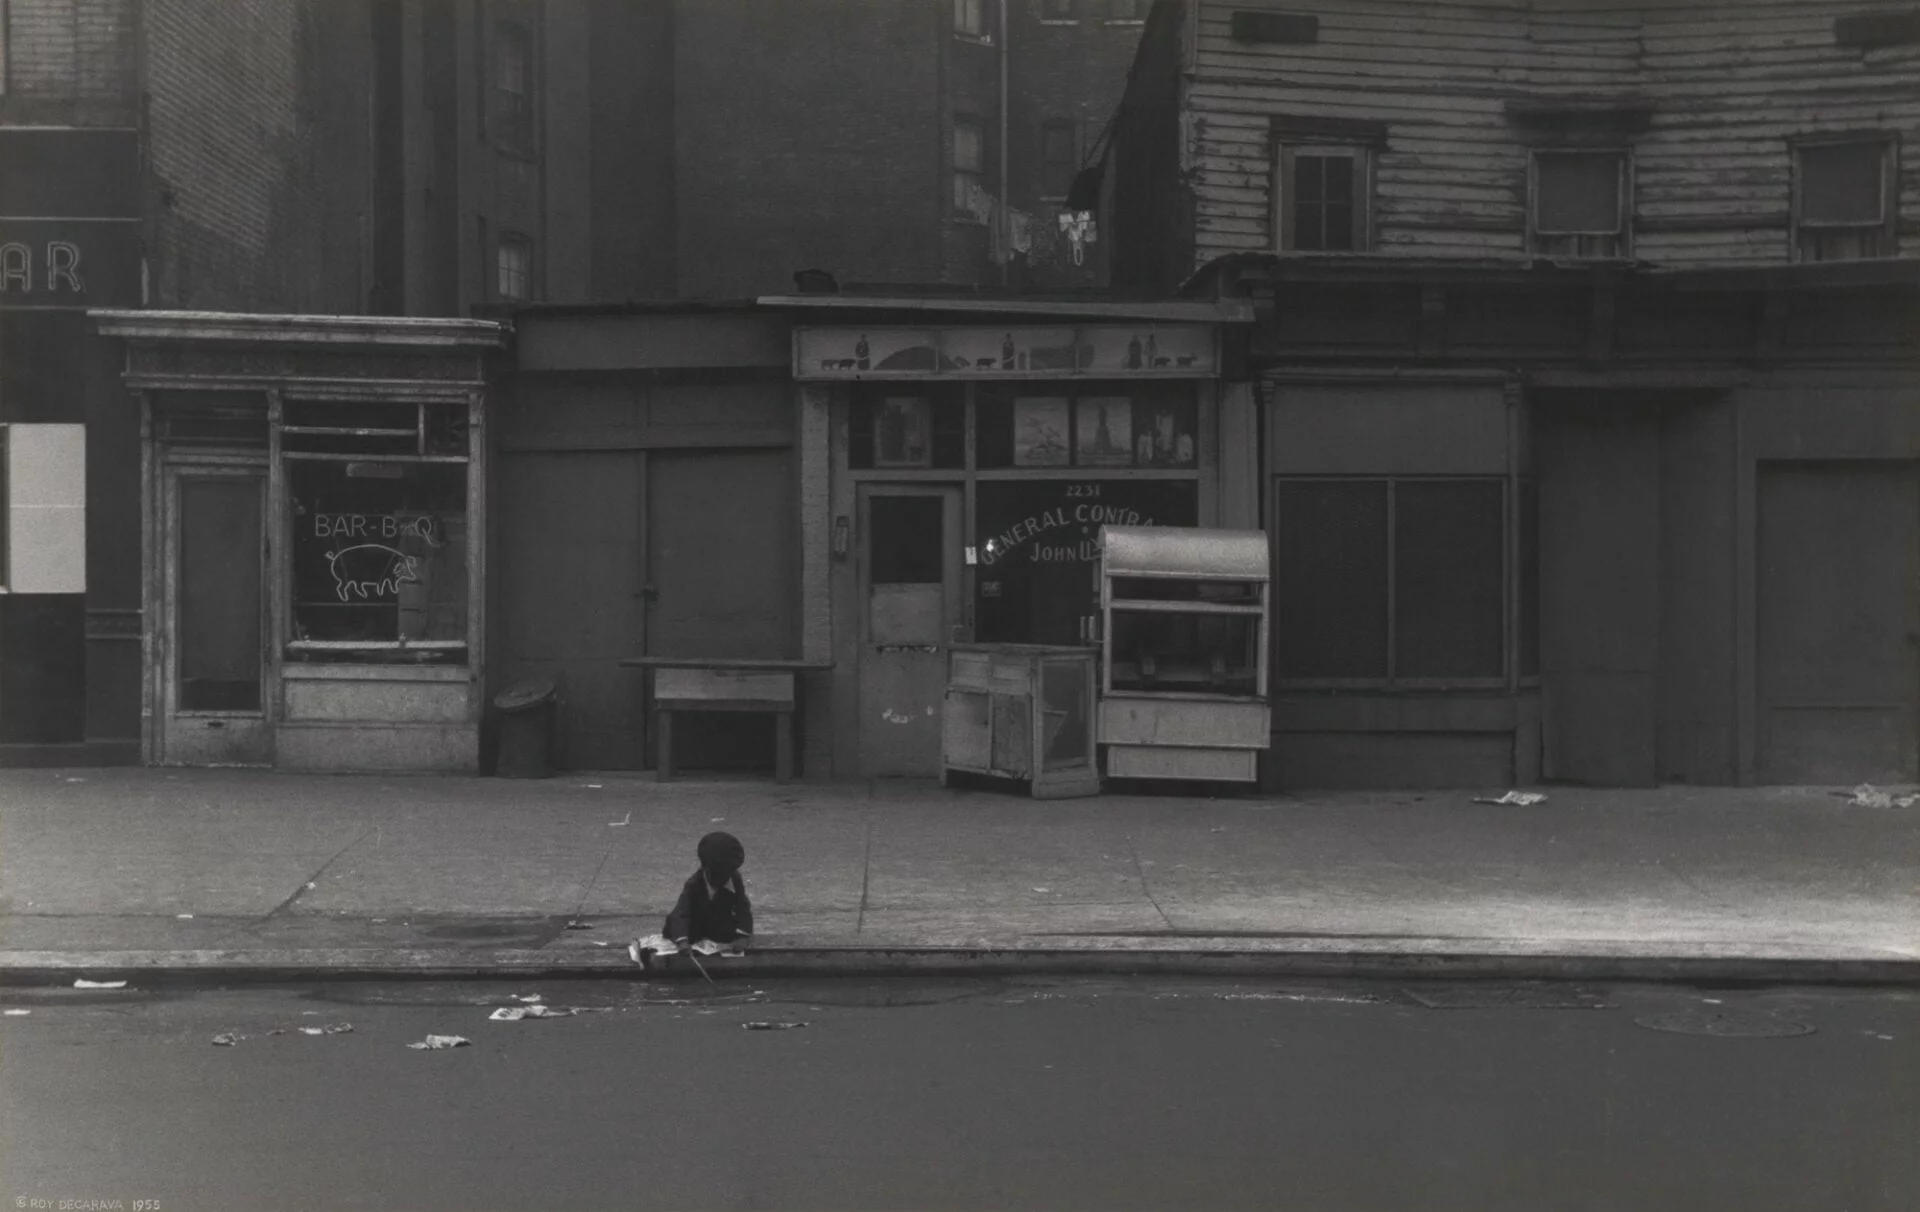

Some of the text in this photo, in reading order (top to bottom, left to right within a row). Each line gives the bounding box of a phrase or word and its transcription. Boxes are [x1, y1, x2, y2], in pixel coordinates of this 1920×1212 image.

[1066, 484, 1100, 497] 2231
[980, 507, 1071, 565] GENERAL
[1030, 541, 1077, 562] JOHN
